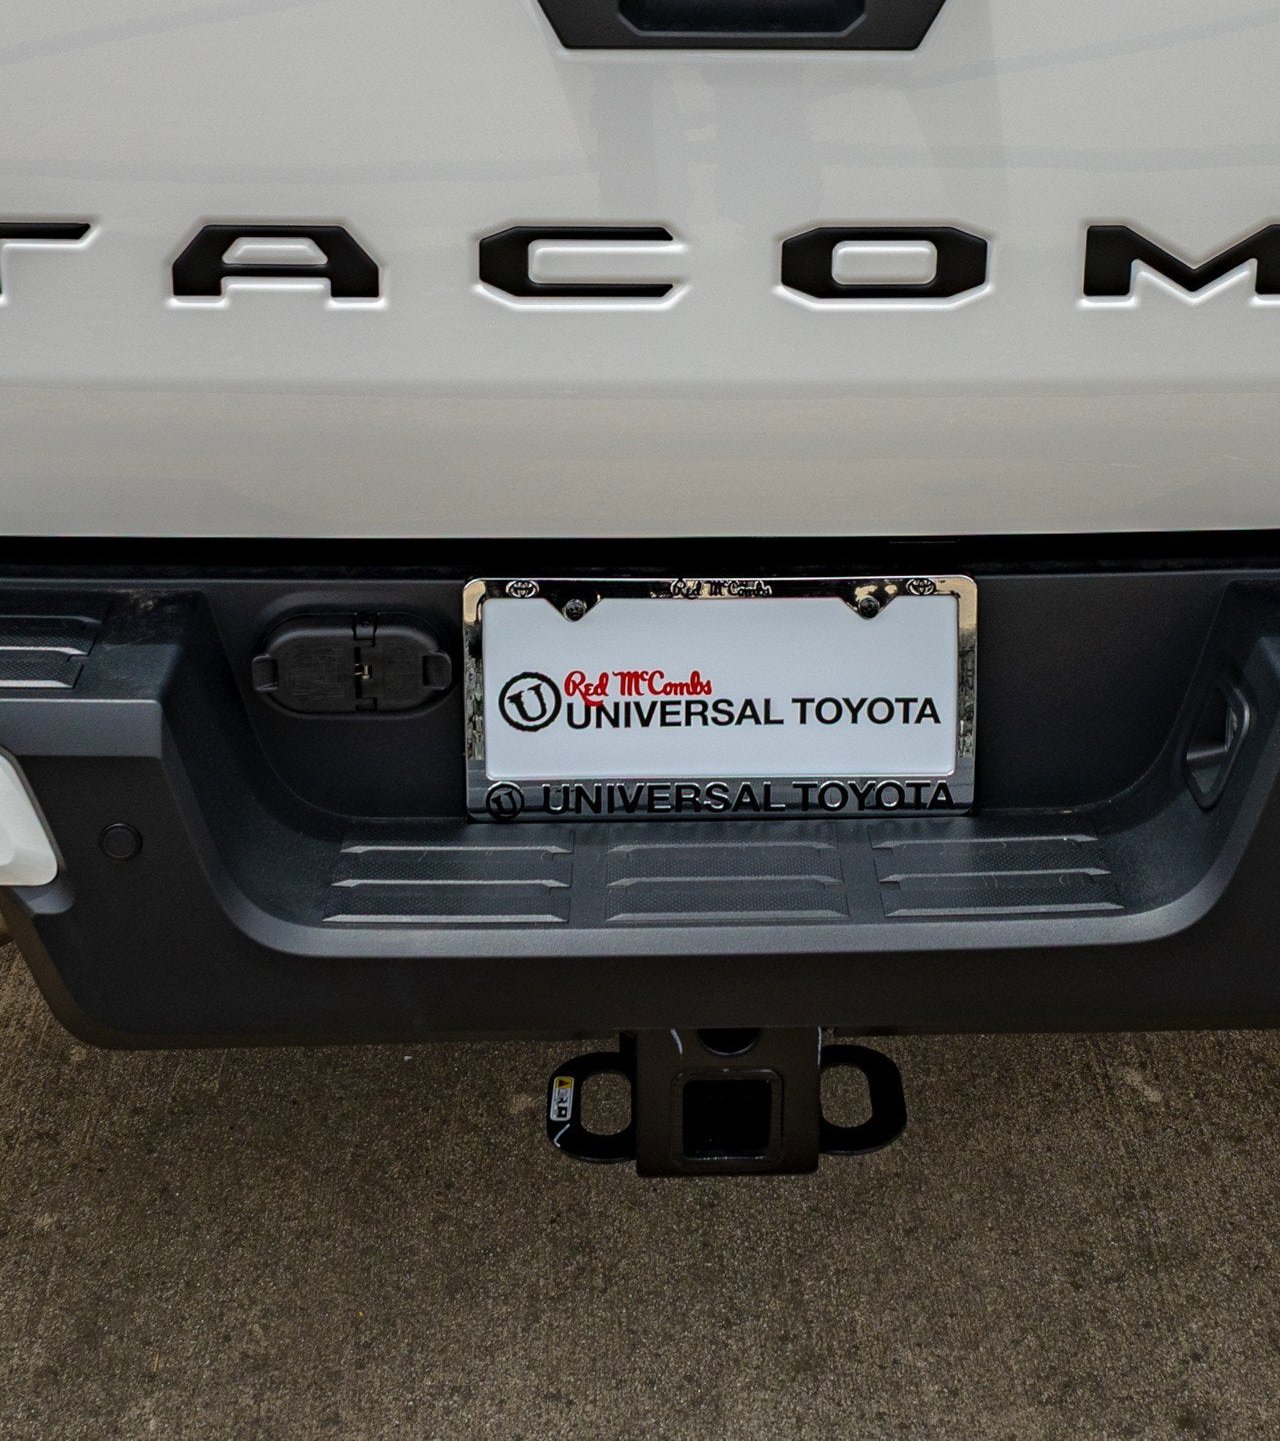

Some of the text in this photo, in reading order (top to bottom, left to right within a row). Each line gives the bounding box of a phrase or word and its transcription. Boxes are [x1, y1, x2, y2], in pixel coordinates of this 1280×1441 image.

[670, 579, 703, 599] Red
[564, 670, 713, 707] Red McCombs
[566, 697, 942, 729] UNIVERSAL TOYOTA
[541, 781, 787, 815] UNIVERSAL
[791, 779, 957, 812] TOYOTA
